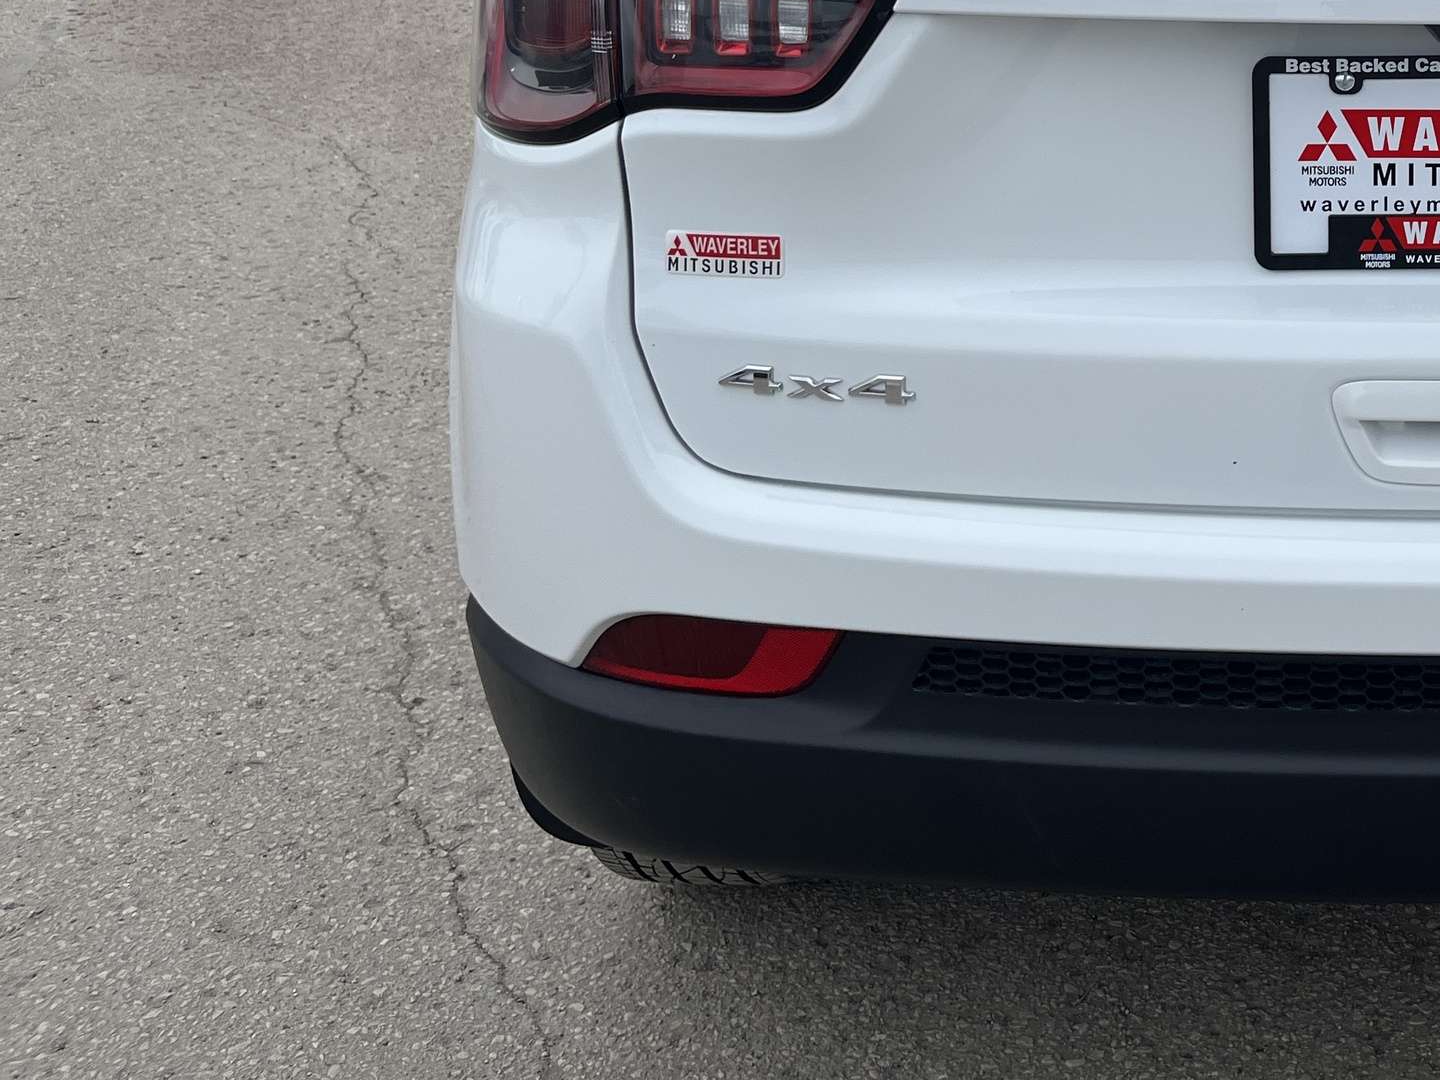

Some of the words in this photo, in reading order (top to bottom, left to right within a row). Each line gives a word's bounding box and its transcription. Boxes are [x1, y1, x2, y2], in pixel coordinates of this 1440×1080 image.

[1285, 58, 1330, 73] Best
[1335, 58, 1409, 73] Backed
[1301, 166, 1355, 175] MITSUBISHI
[1309, 177, 1347, 187] MOTORS
[693, 236, 779, 256] WAVERLEY
[668, 256, 781, 276] MITSUBISHI
[1365, 260, 1391, 268] MOTORS
